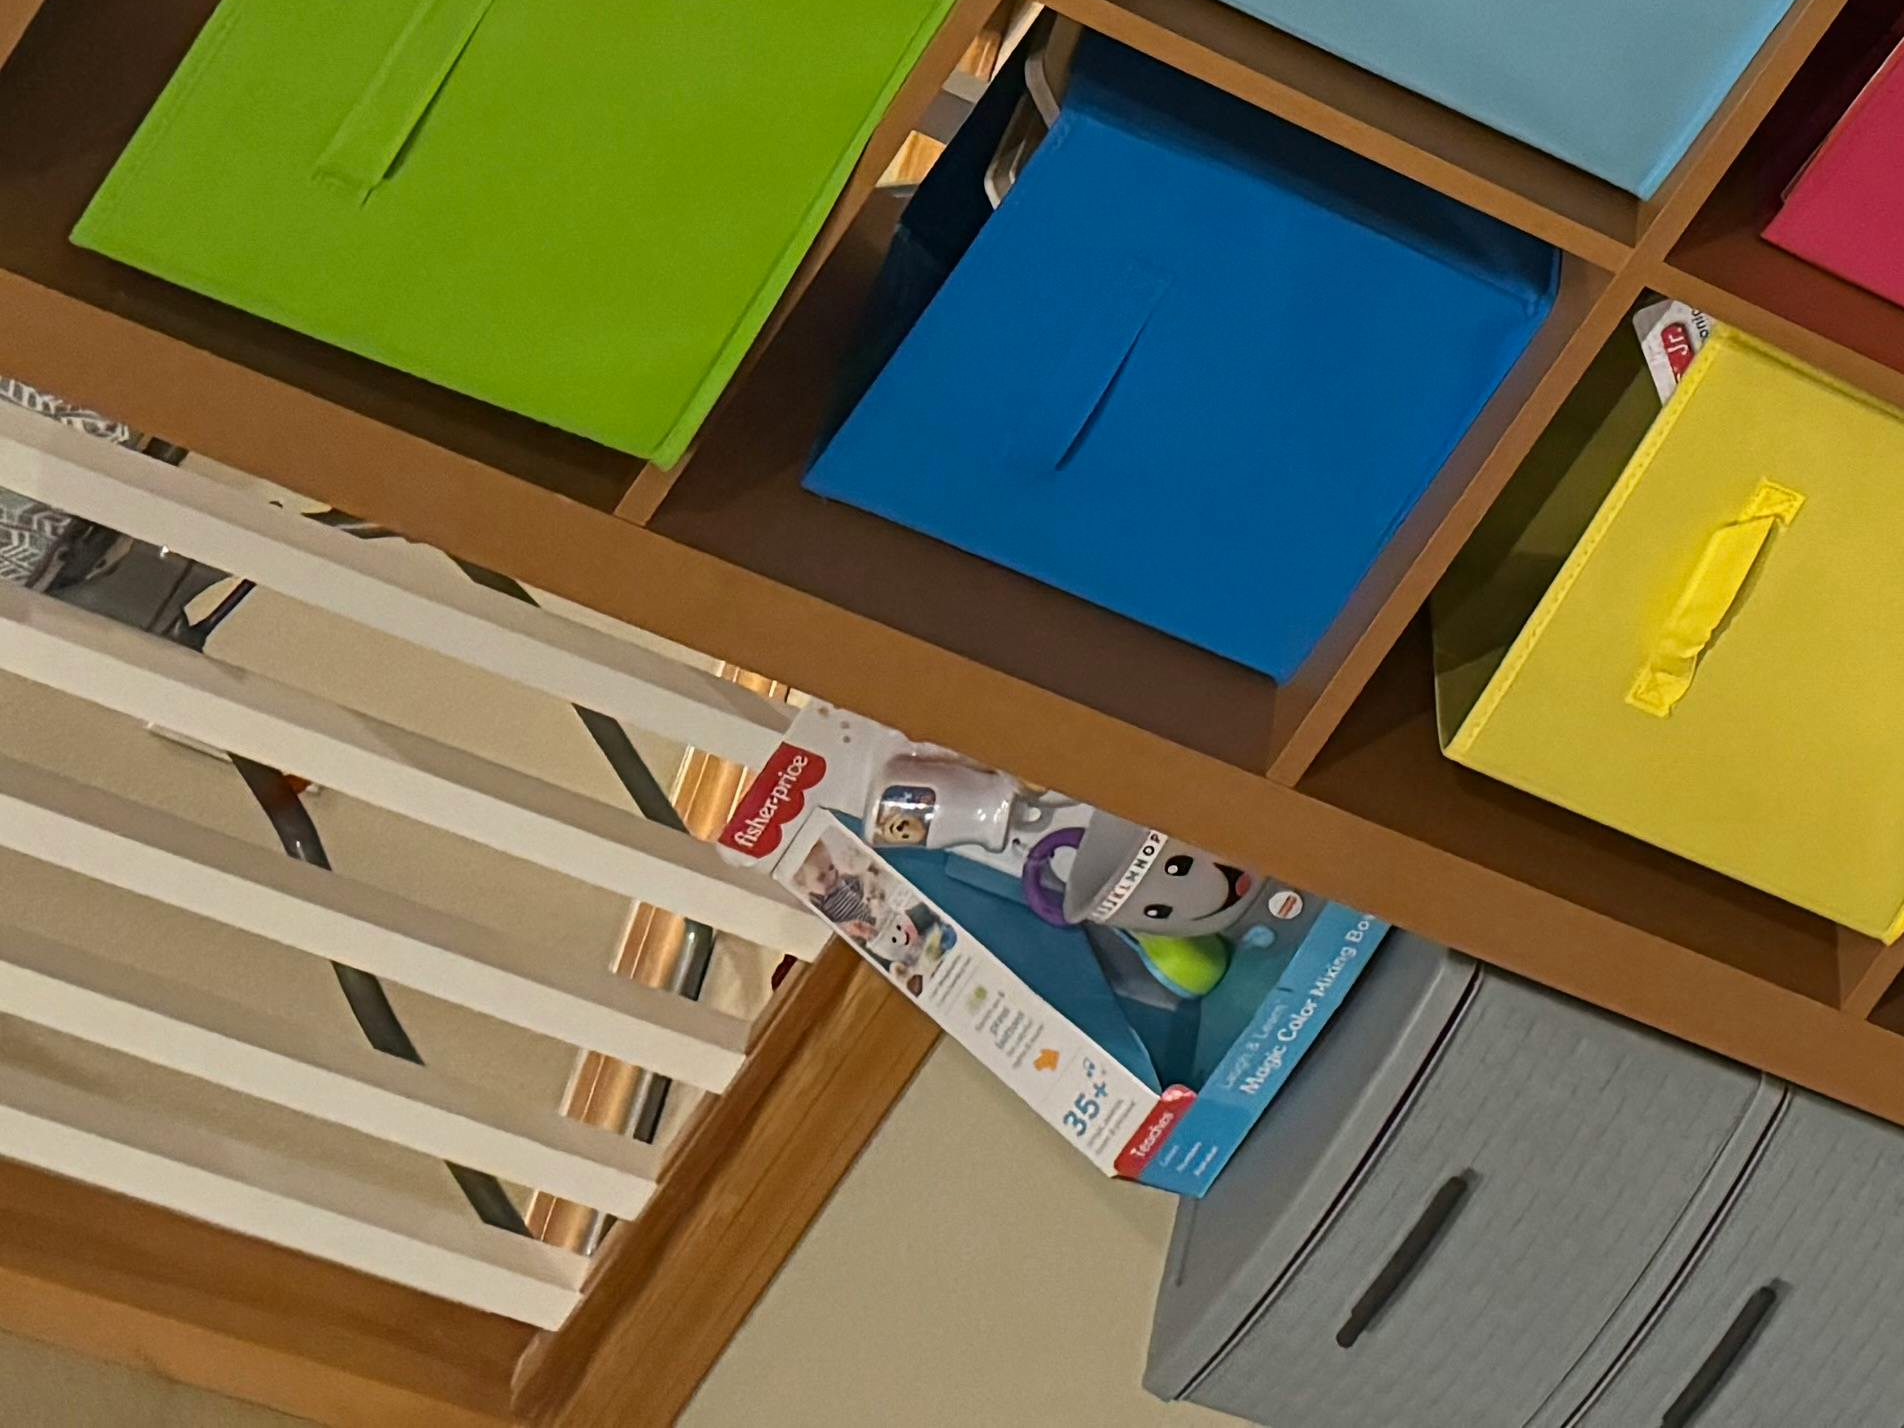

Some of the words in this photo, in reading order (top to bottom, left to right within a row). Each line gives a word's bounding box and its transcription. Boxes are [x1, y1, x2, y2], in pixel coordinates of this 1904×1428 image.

[734, 755, 808, 848] fisher-price
[1239, 1044, 1287, 1094] Magic
[1277, 998, 1318, 1042] Color
[1310, 946, 1358, 997] Mixing
[1062, 1081, 1109, 1137] 35+
